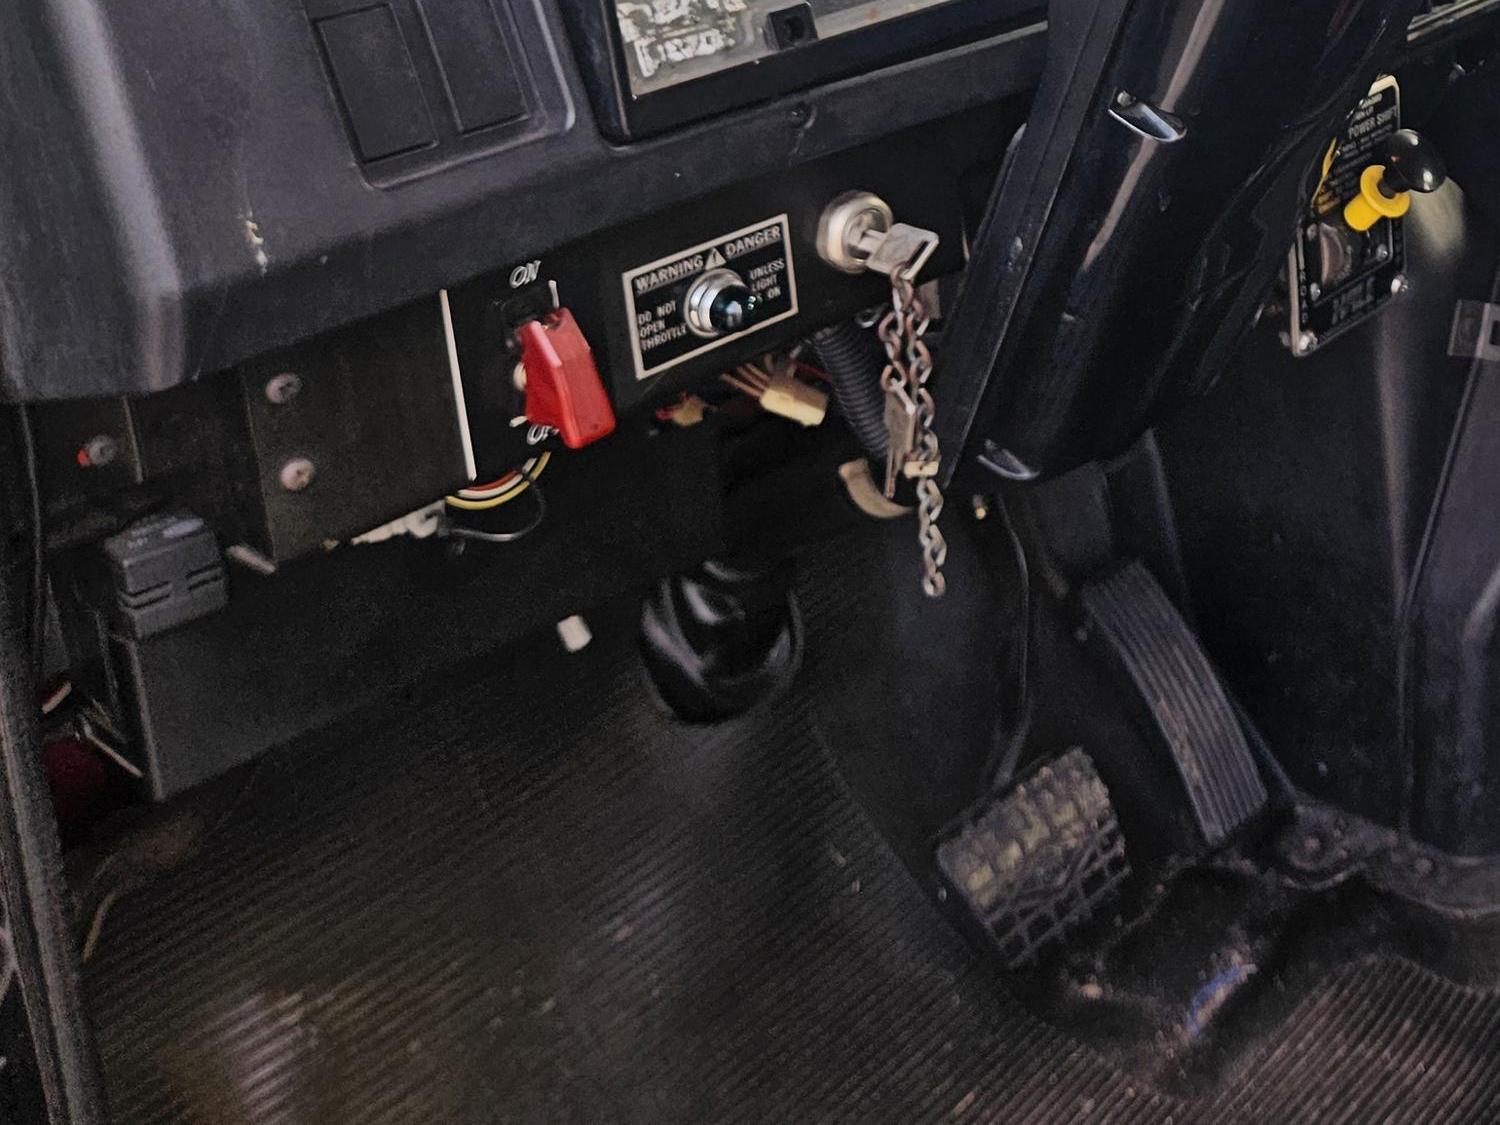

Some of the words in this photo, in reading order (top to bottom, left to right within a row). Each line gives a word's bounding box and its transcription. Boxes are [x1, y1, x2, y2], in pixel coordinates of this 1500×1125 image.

[635, 255, 704, 291] WARNING
[725, 225, 782, 257] DANGER
[750, 258, 785, 280] UNLESS
[509, 259, 542, 288] ON
[752, 274, 778, 293] LIGHT
[767, 286, 781, 300] ON
[637, 310, 652, 325] DO
[656, 299, 678, 317] NOT
[639, 319, 666, 339] OPEN
[640, 324, 687, 352] THROTTLE
